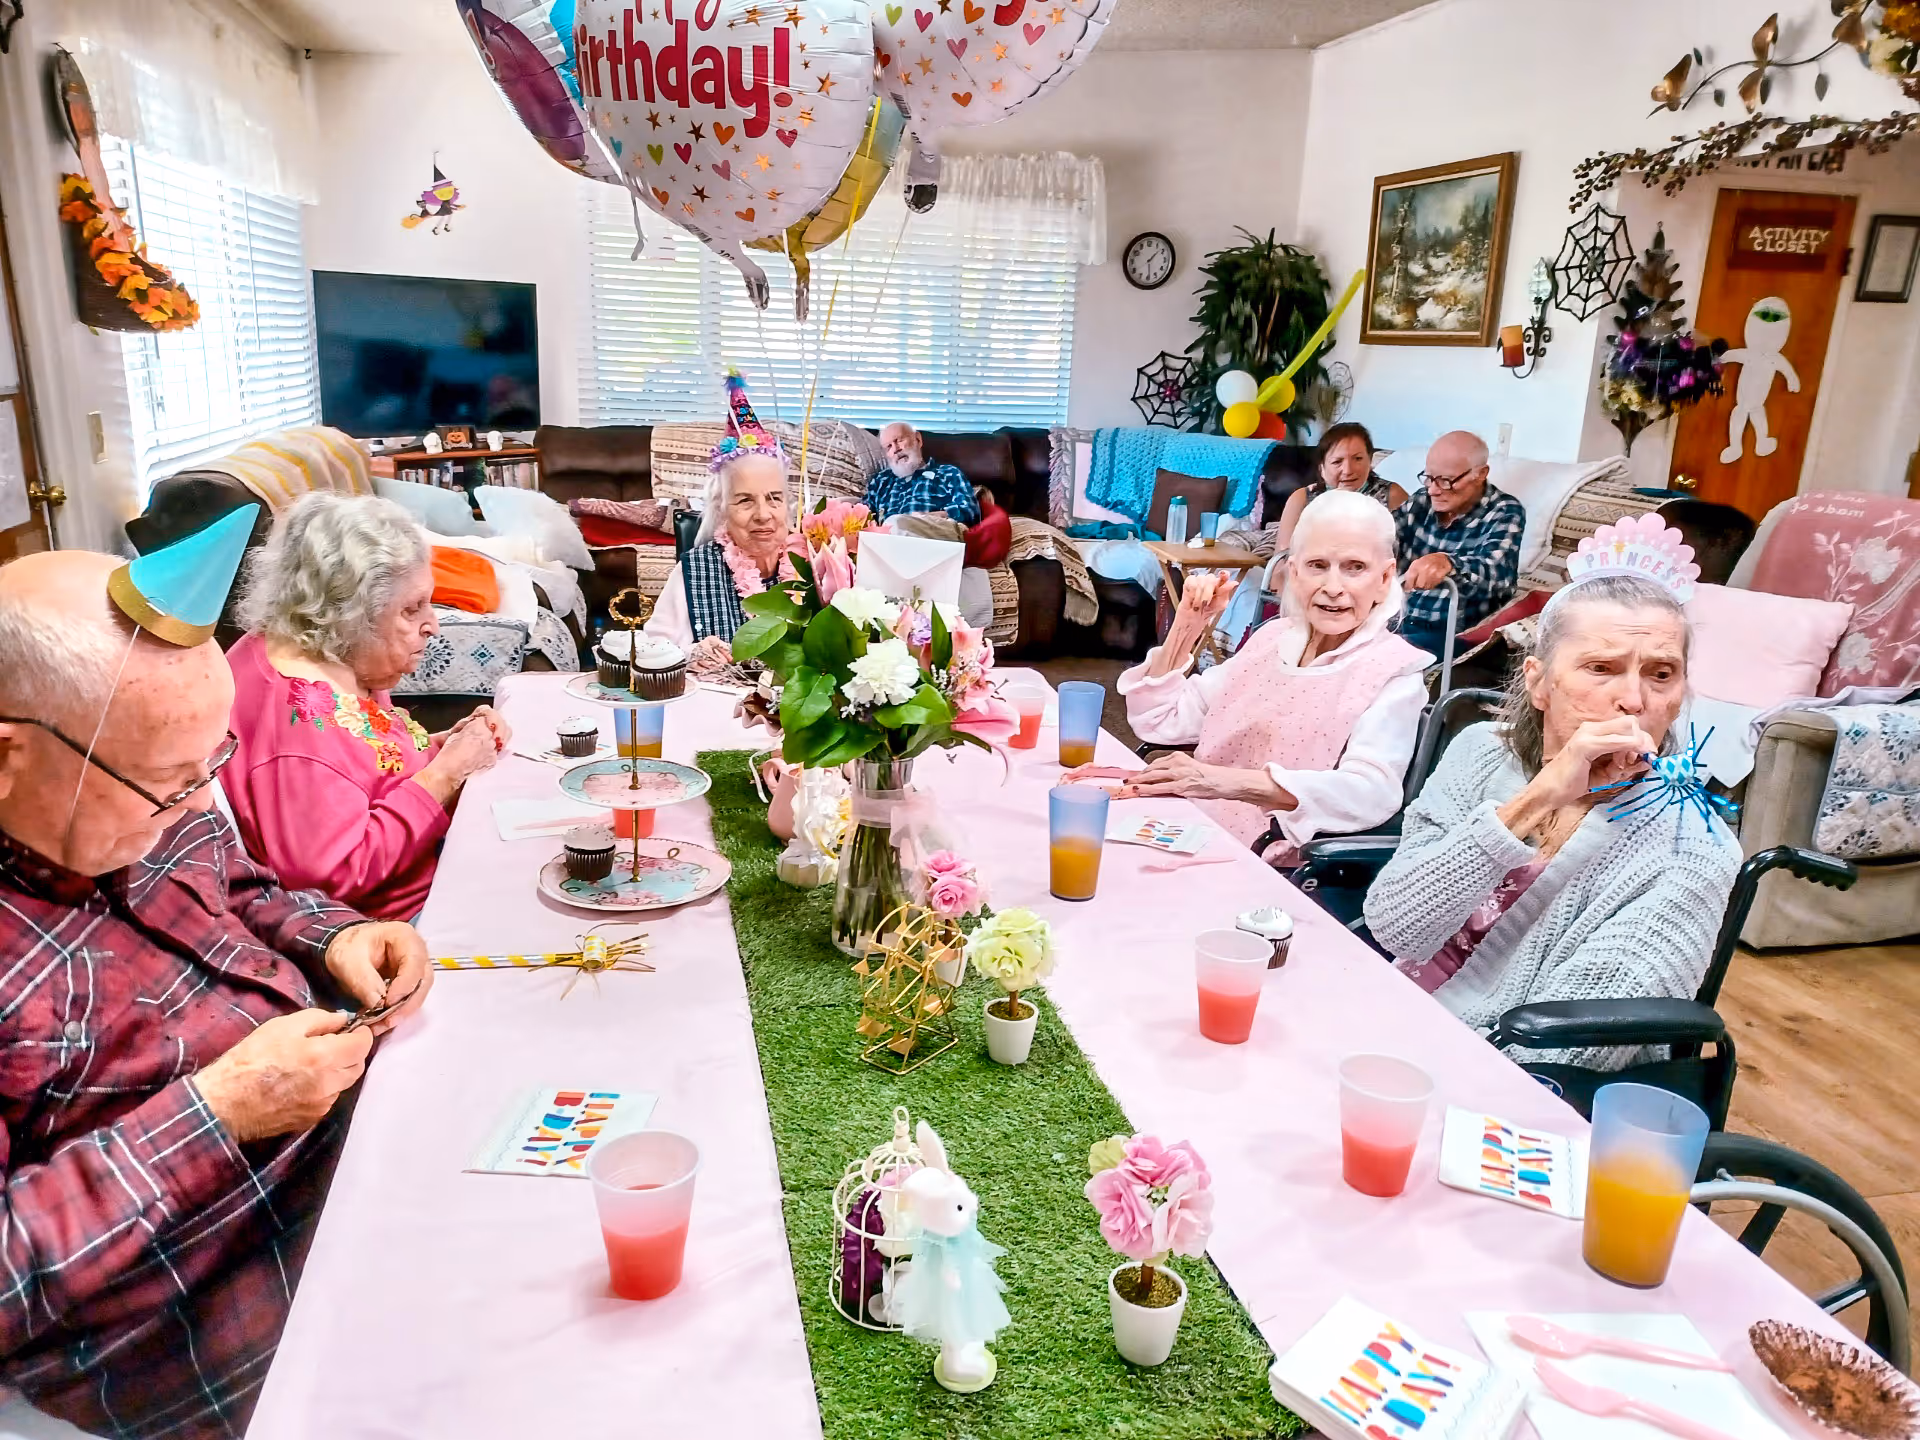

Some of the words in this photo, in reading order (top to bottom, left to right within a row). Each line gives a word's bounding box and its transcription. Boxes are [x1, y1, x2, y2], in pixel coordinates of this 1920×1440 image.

[1748, 226, 1830, 242] ACTIVITY
[1753, 238, 1820, 254] CLOSET
[1584, 550, 1687, 590] PRINCESS
[1319, 1321, 1418, 1426] HAPPY
